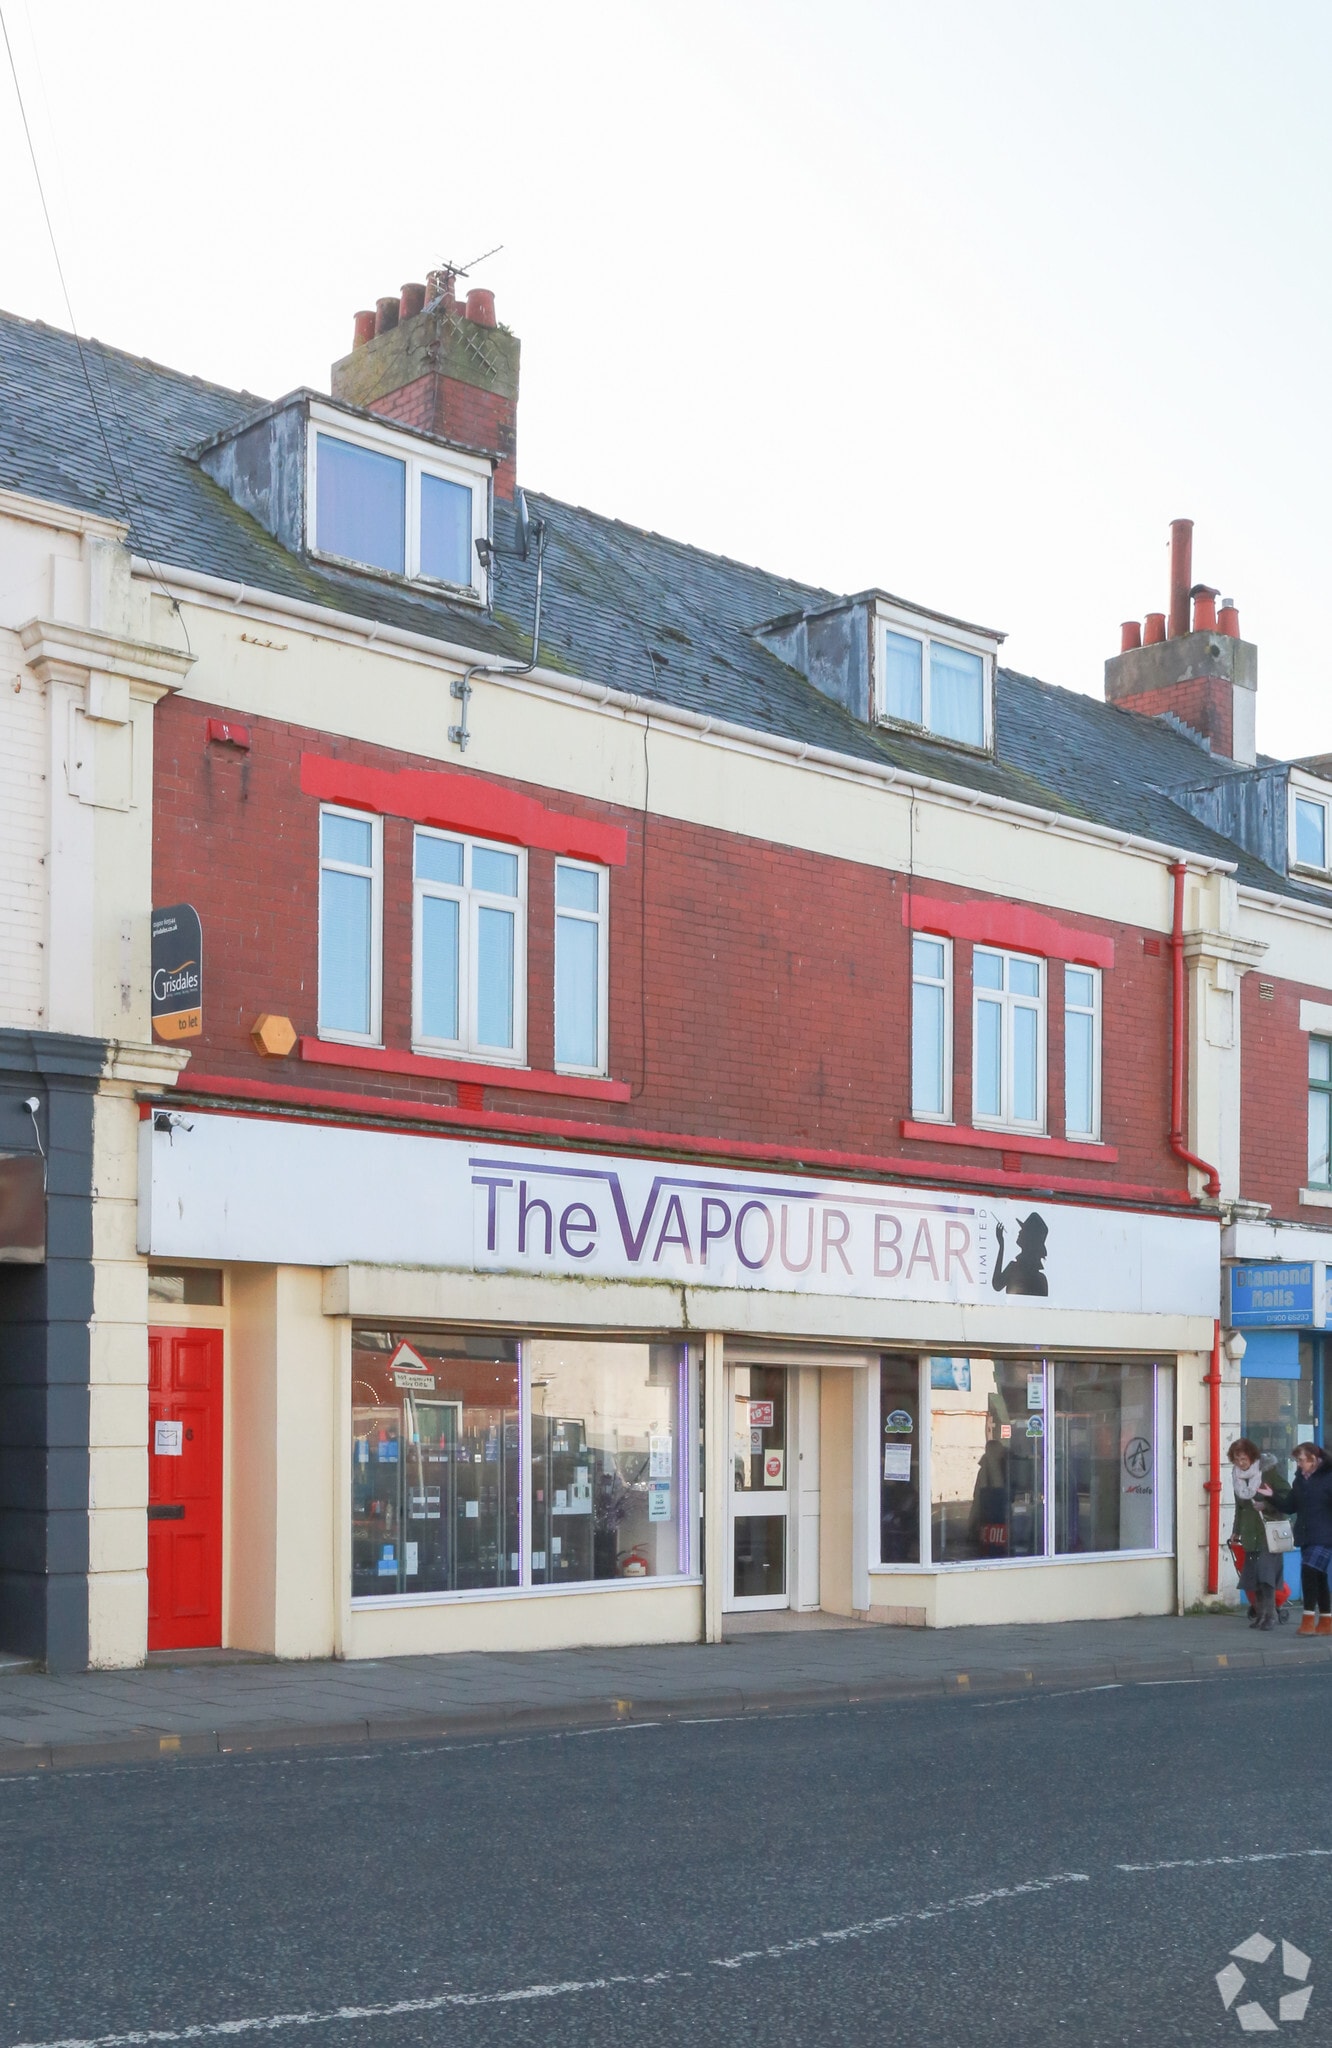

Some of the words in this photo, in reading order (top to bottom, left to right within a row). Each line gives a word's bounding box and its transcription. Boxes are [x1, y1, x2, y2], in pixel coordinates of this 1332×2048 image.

[153, 968, 198, 1001] Grisdales
[179, 1019, 187, 1030] to
[188, 1015, 198, 1028] let
[471, 1175, 597, 1258] The
[607, 1172, 854, 1275] VAPOUR
[874, 1213, 975, 1284] BAR
[979, 1209, 987, 1285] LIMITED
[1236, 1266, 1311, 1288] Diamond
[1252, 1289, 1295, 1307] Nails
[990, 1527, 1006, 1543] OIL
